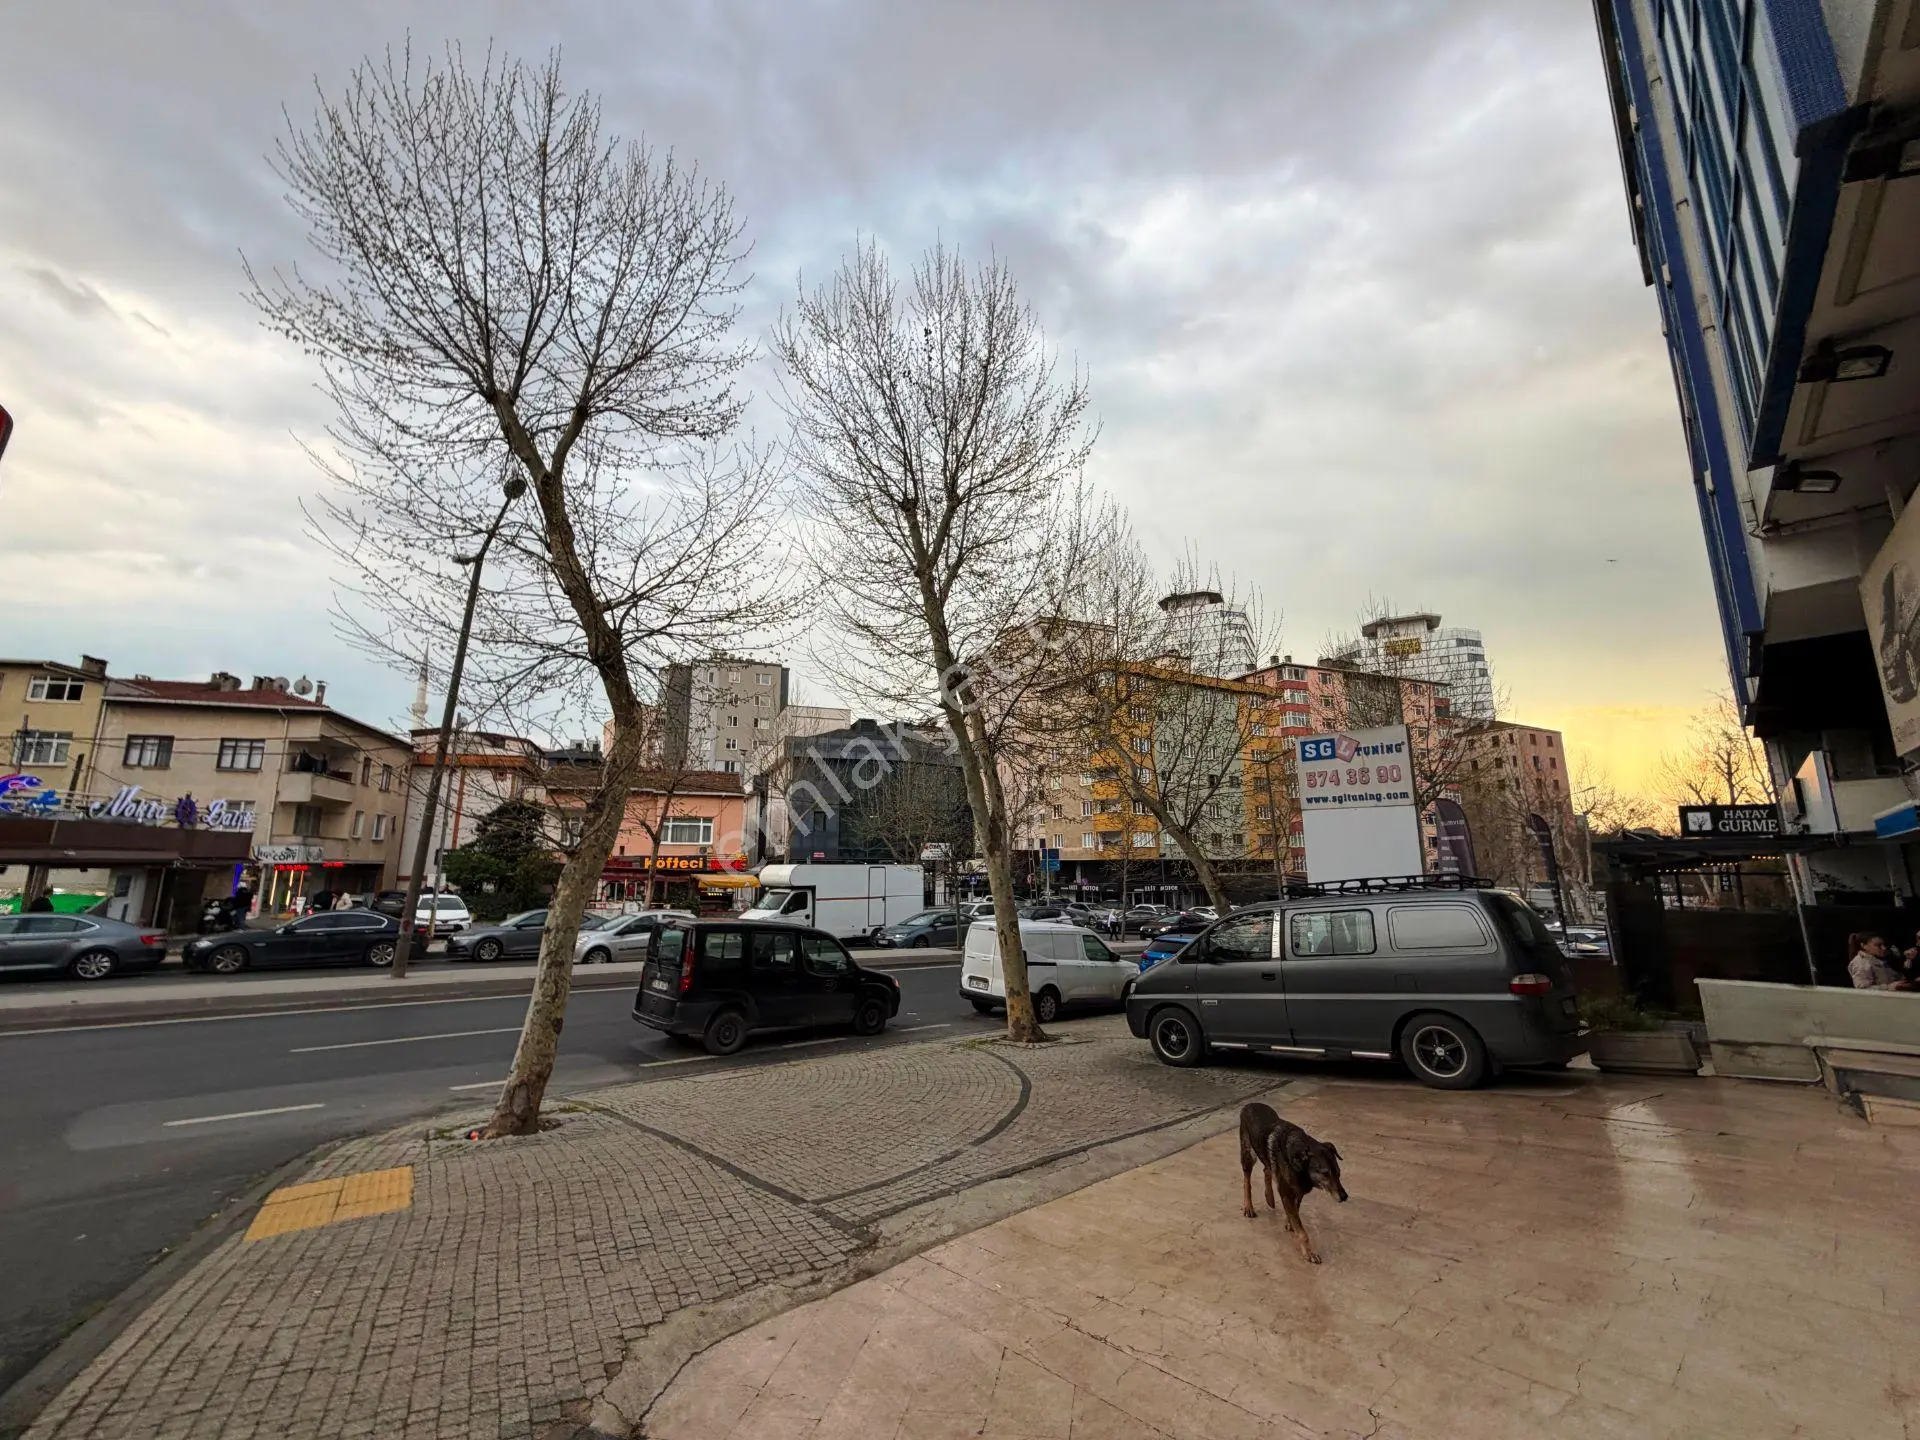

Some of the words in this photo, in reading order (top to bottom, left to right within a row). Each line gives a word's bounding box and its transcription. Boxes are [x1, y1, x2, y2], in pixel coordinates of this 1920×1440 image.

[1306, 769, 1341, 788] 574
[1346, 767, 1371, 785] 36
[1376, 764, 1402, 783] 90
[1306, 791, 1409, 804] www.sgltuning.com
[1723, 809, 1769, 819] HATAY
[1718, 819, 1779, 832] GURME
